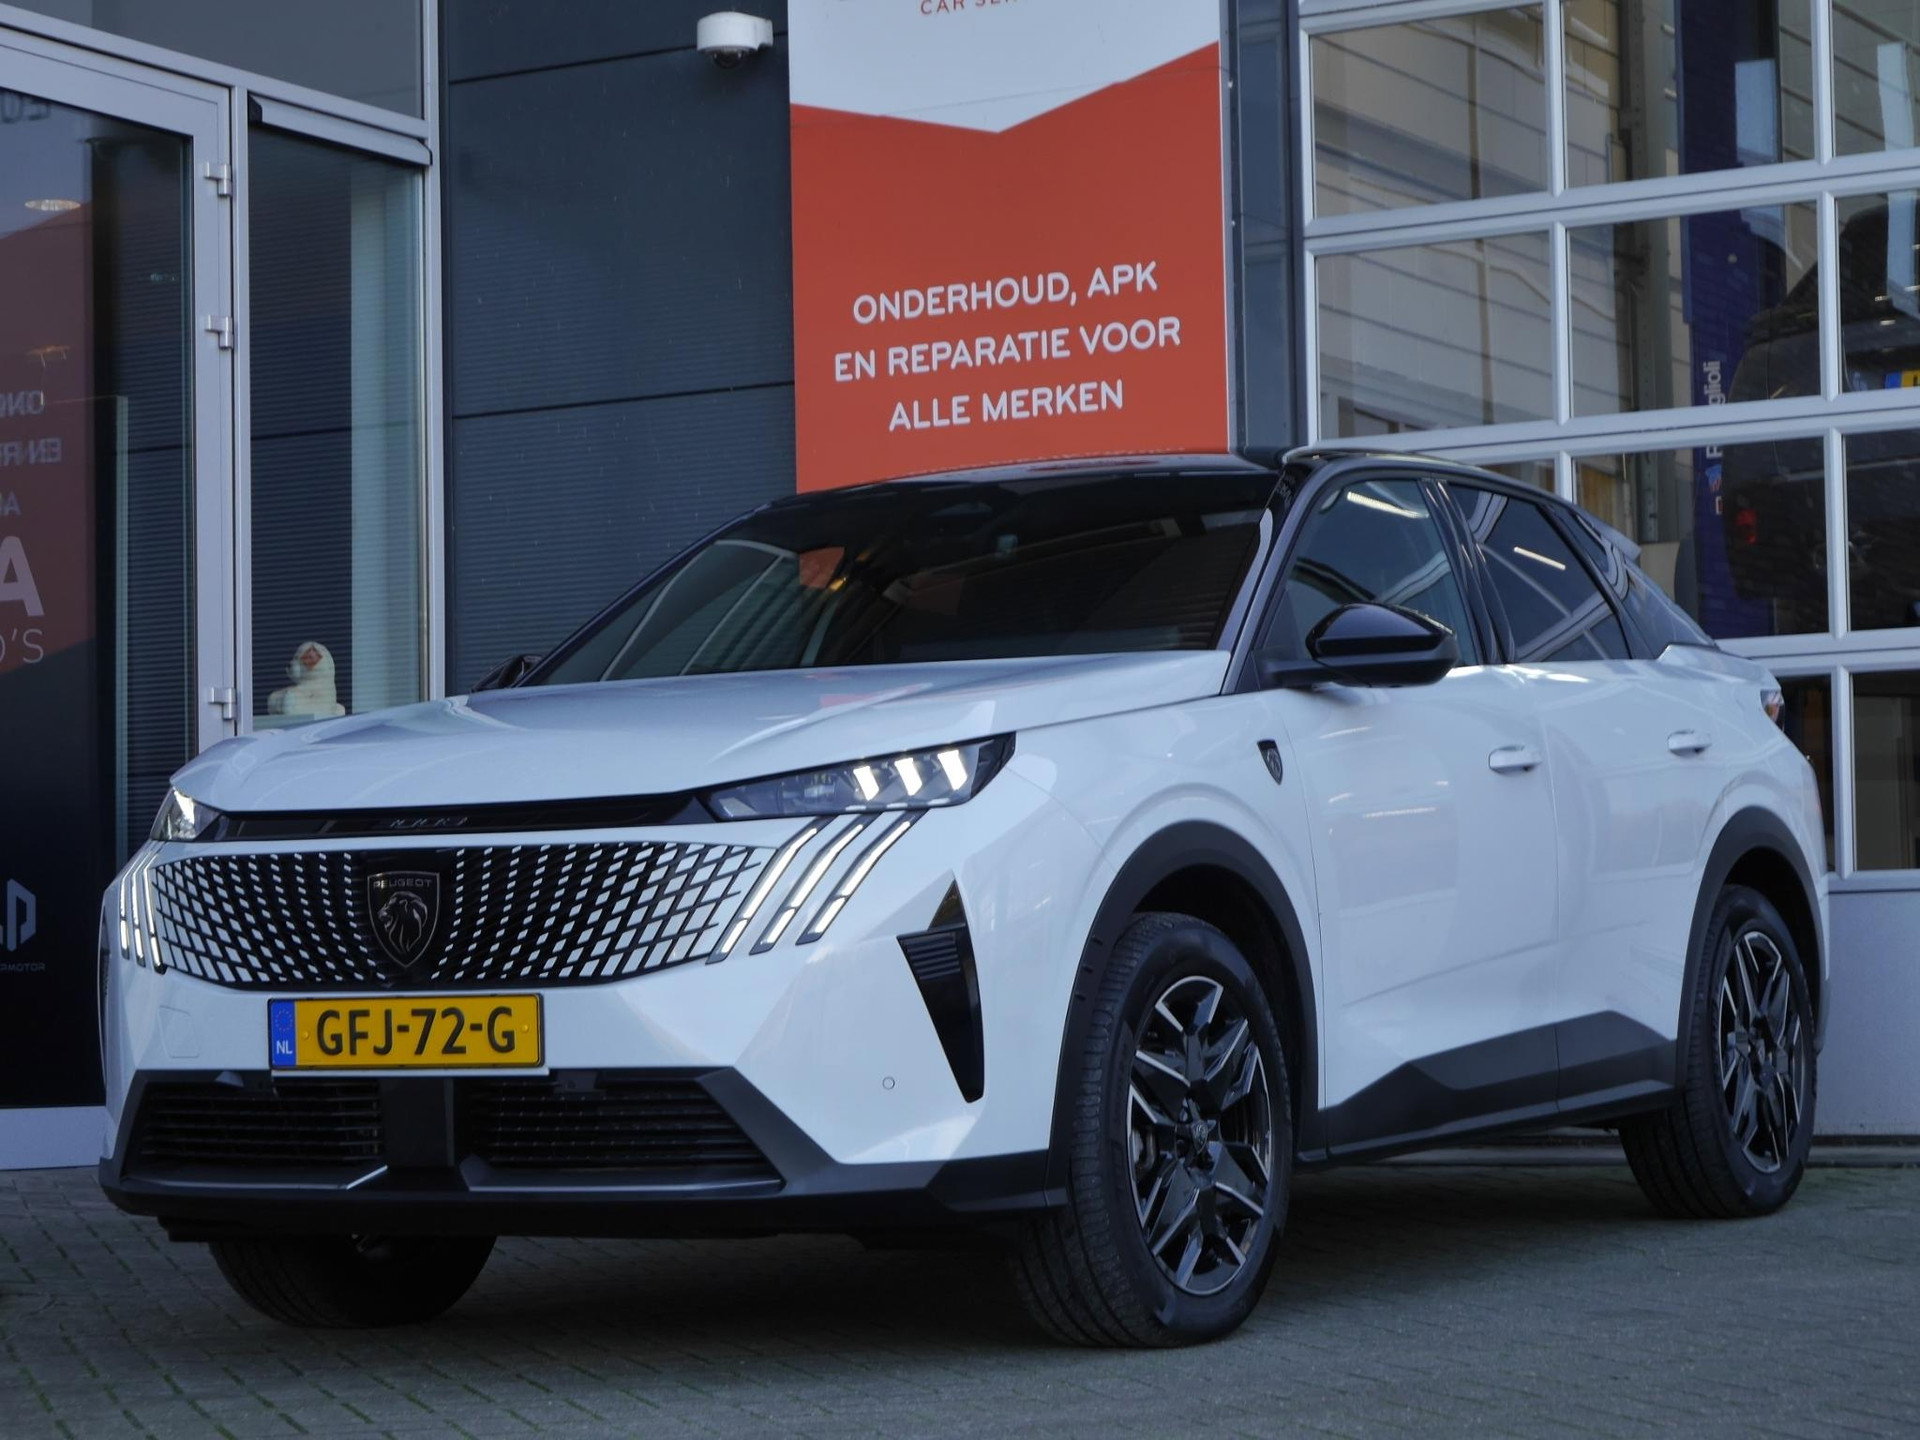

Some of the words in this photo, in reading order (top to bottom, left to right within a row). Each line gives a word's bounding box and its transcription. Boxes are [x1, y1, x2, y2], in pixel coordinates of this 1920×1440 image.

[853, 271, 1076, 325] ONDERHOUD,
[1087, 261, 1158, 298] APK
[835, 350, 876, 381] EN
[888, 327, 1071, 376] REPARATIE
[1079, 316, 1181, 355] VOOR
[889, 395, 970, 431] ALLE
[982, 379, 1123, 422] MERKEN
[373, 878, 432, 889] PEUGEOT
[276, 1040, 293, 1056] NL
[316, 1006, 516, 1056] GFJ-72-G
